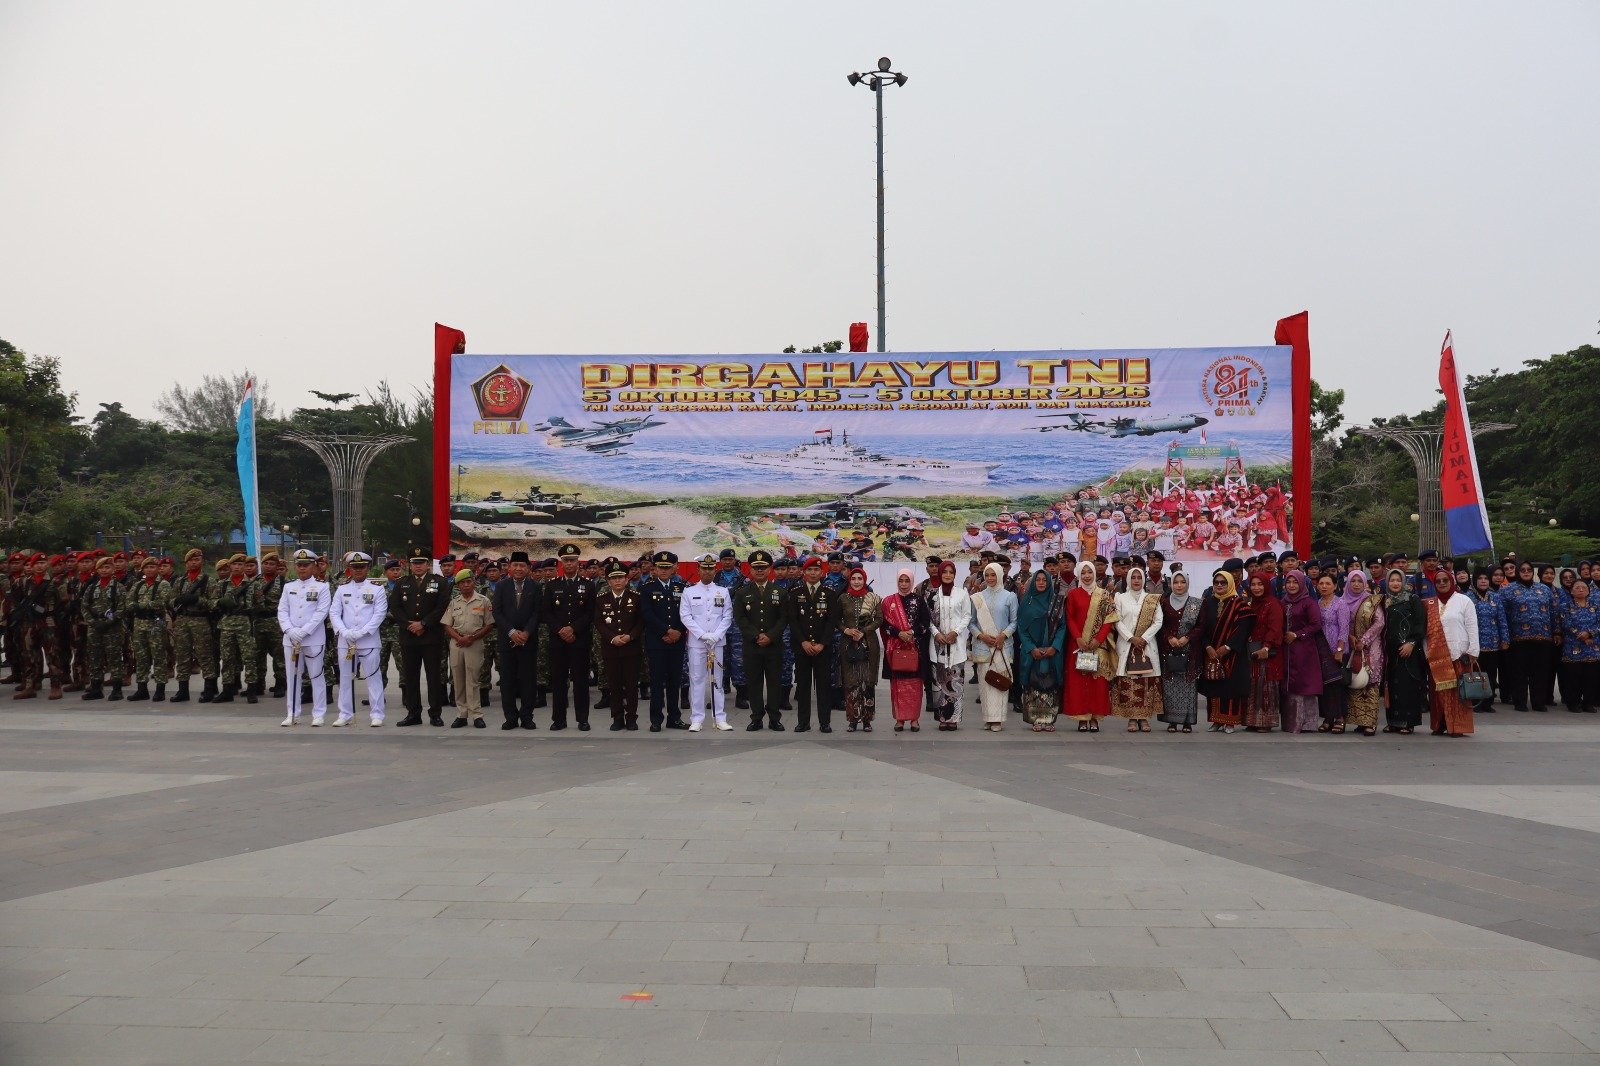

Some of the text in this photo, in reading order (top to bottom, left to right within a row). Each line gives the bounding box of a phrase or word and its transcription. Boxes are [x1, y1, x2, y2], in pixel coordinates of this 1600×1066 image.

[582, 358, 1151, 389] DIRGAHAYU TNI
[1204, 356, 1232, 378] NASIONAL
[1233, 355, 1265, 375] INDONESIA
[581, 390, 612, 403] 5
[618, 390, 755, 403] OKTOBER
[759, 388, 842, 403] 1945
[876, 388, 904, 402] 5
[910, 388, 1053, 402] OKTOBER
[1055, 385, 1151, 401] 2026
[1201, 379, 1213, 406] TENTARA
[582, 404, 609, 413] TNI
[612, 404, 654, 413] KUAT
[658, 403, 734, 413] BERSAMA
[806, 402, 895, 412] INDONESIA
[1035, 401, 1070, 409] DAN
[1074, 400, 1152, 409] MAKMUR
[474, 421, 528, 434] PRIMA
